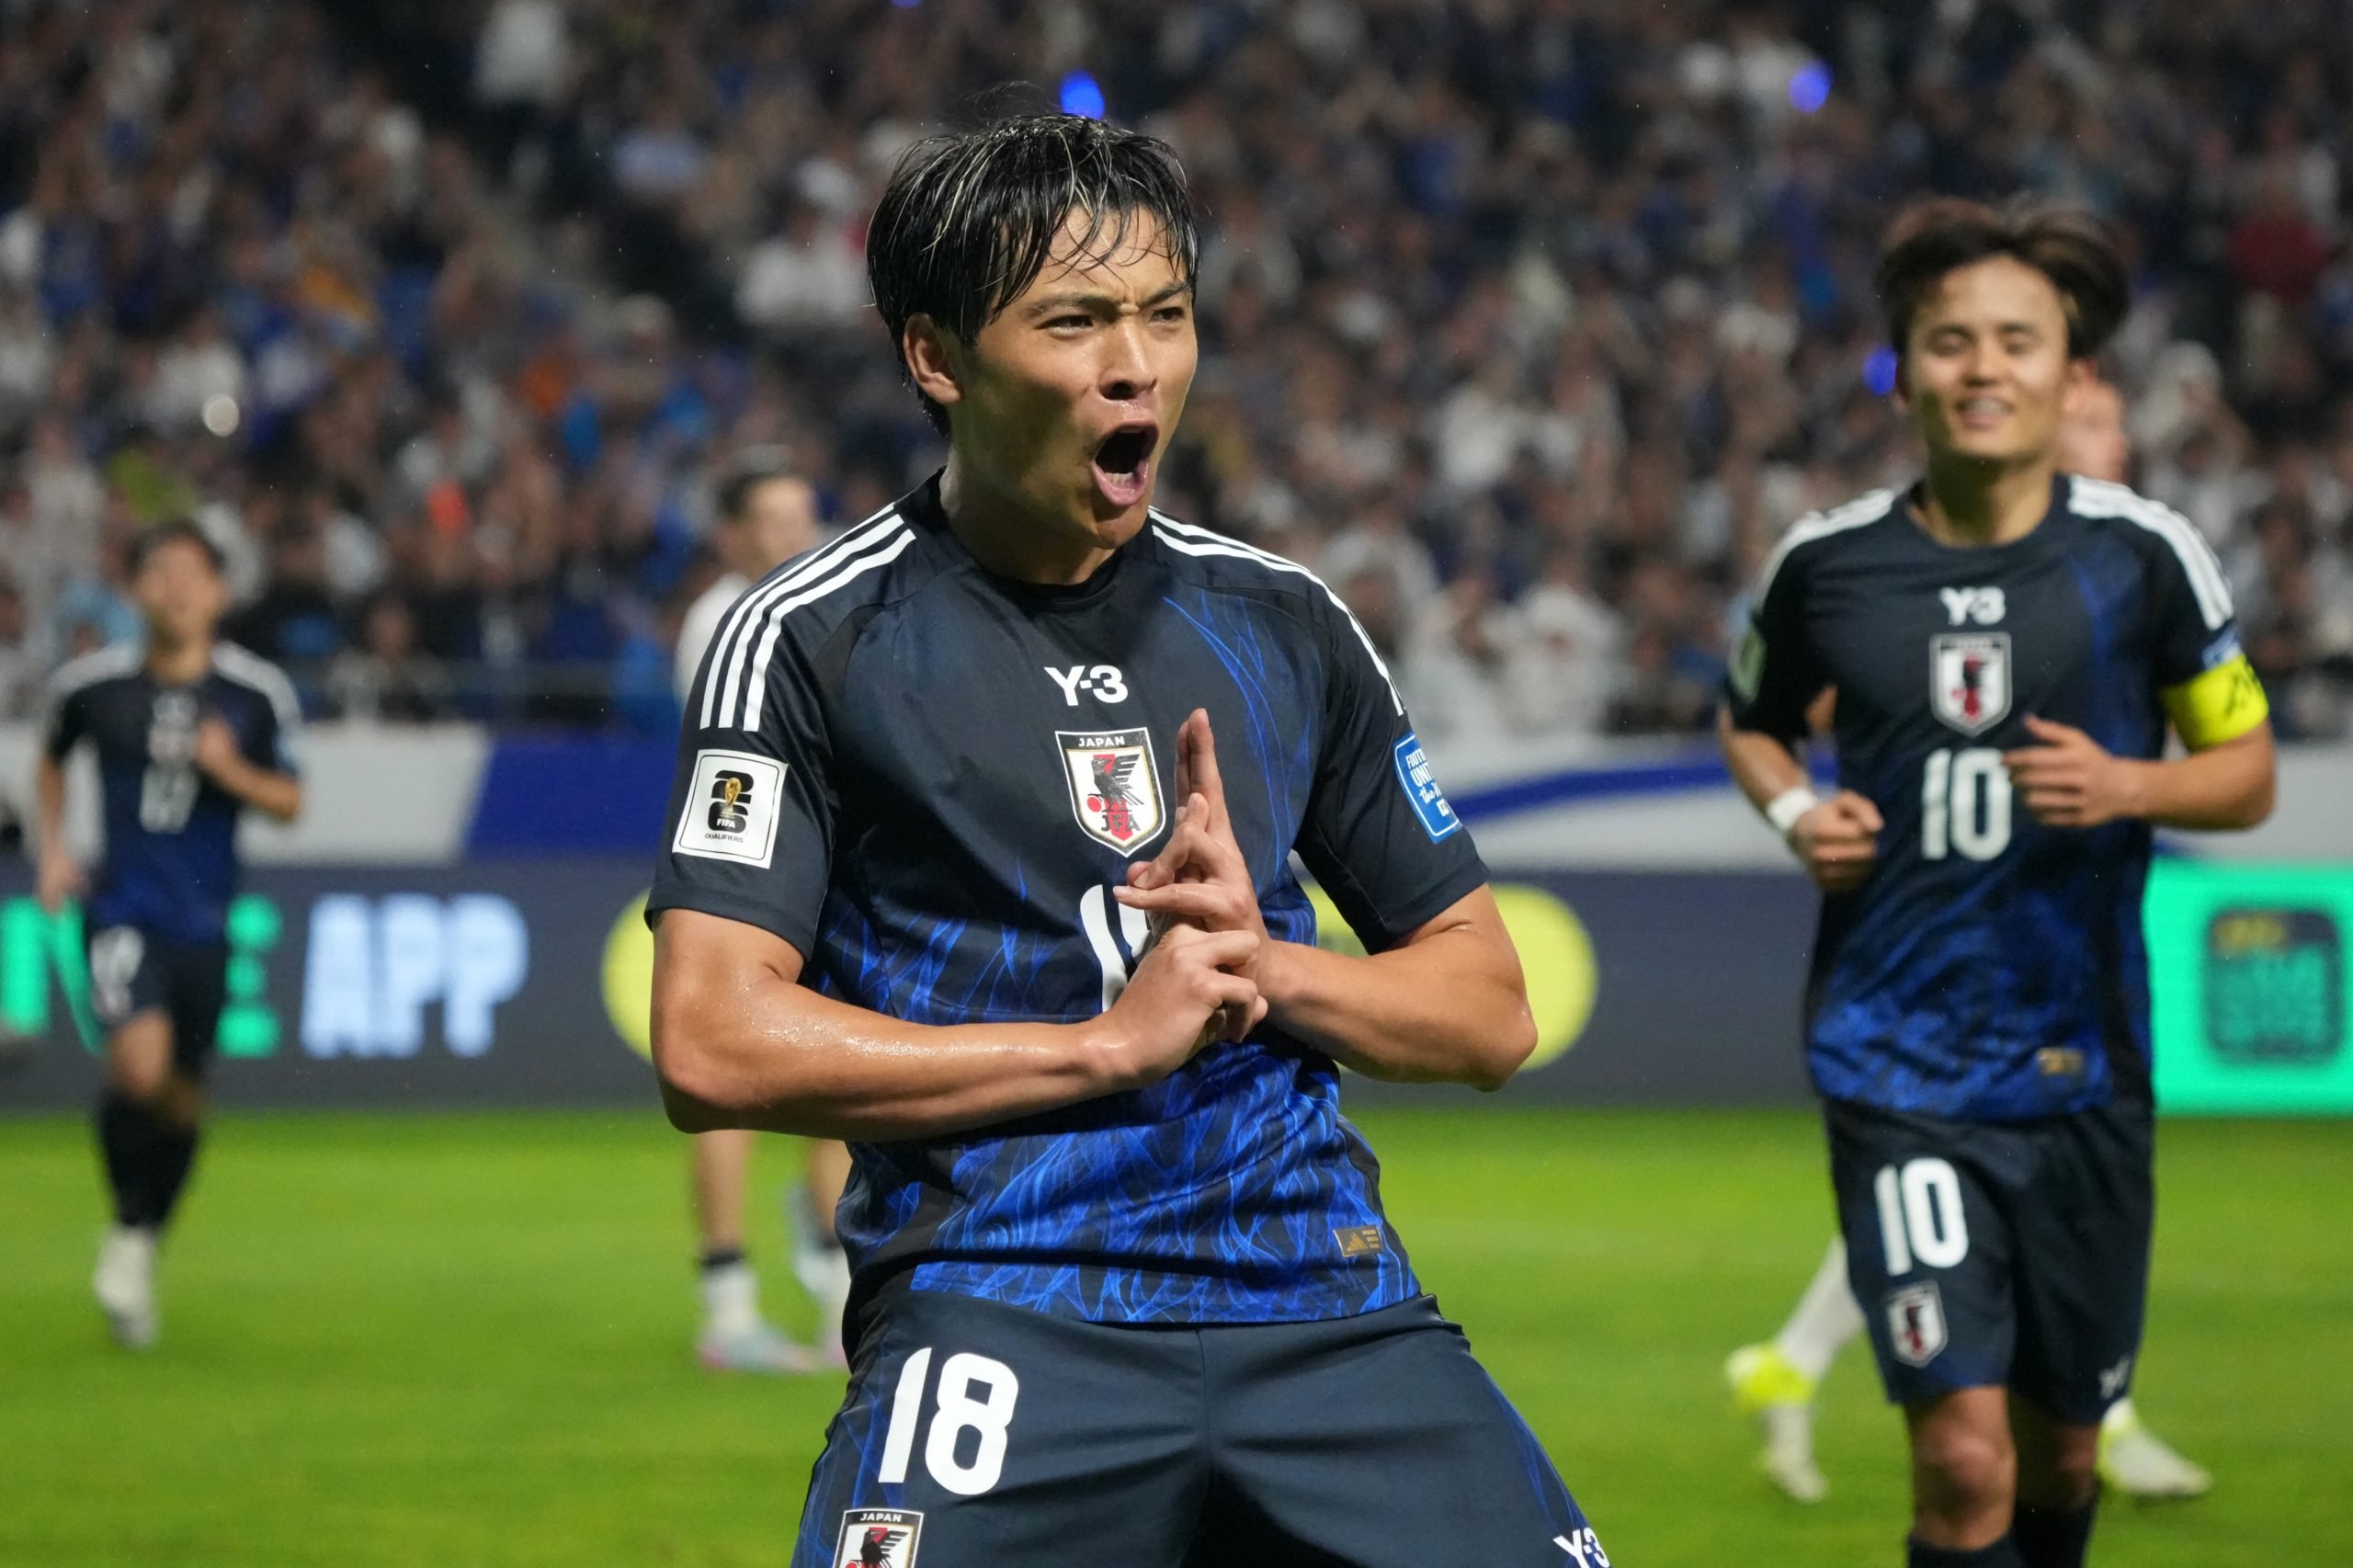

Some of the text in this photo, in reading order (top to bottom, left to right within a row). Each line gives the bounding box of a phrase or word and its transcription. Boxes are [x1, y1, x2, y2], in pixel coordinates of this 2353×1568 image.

[1043, 665, 1129, 707] Y-3
[1078, 735, 1126, 748] JAPAN
[716, 818, 736, 828] FIFA
[1100, 813, 1142, 832] JFA
[1921, 747, 2013, 861] 10
[704, 832, 744, 844] QUALIFIERS
[1079, 883, 1151, 1012] 1
[301, 892, 529, 1058] APP
[1873, 1156, 1969, 1277] 10
[878, 1346, 1019, 1495] 18
[859, 1512, 903, 1523] JAPAN
[1552, 1527, 1610, 1568] Y-3
